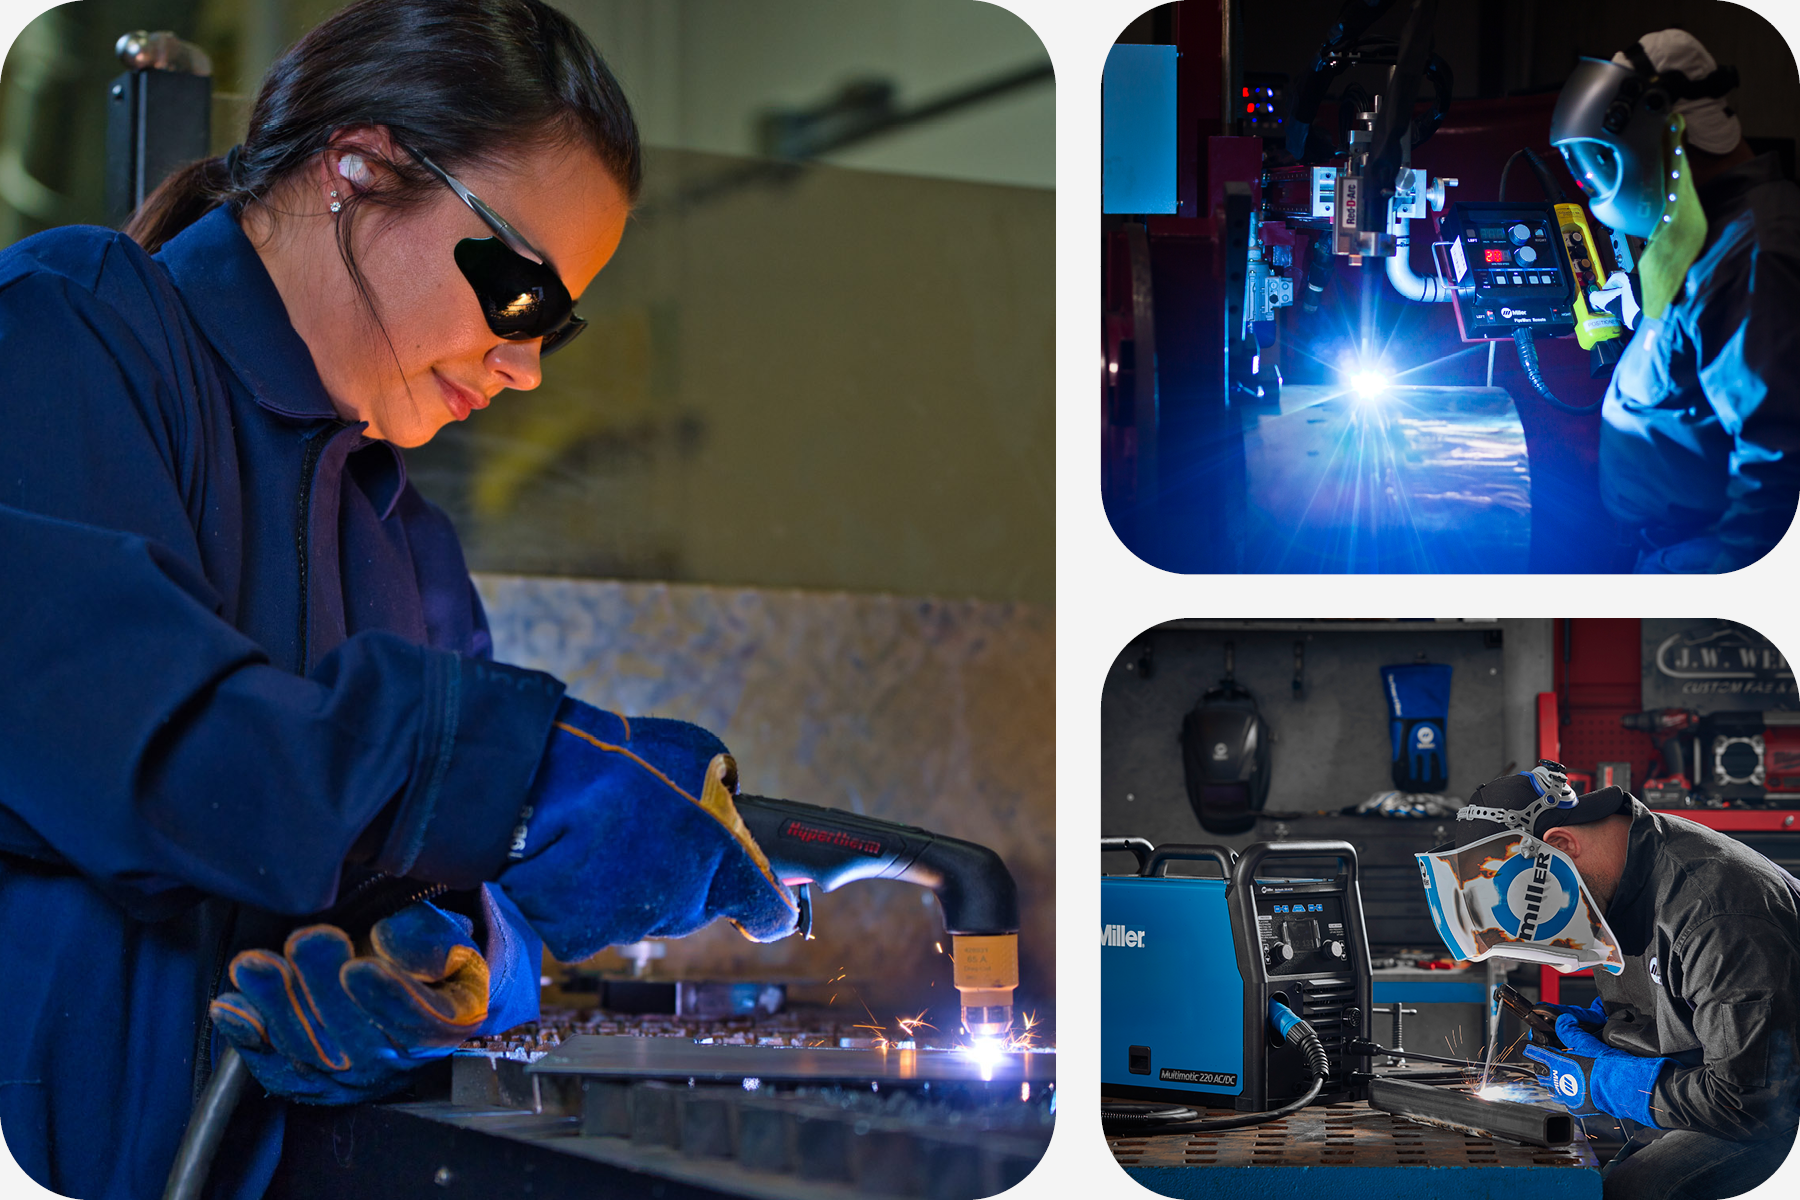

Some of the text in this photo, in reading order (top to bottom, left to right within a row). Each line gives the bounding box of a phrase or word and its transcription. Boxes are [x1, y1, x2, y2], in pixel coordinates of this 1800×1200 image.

[1346, 184, 1356, 225] Red-D-Arc
[1682, 681, 1741, 694] CUSTOM
[787, 821, 881, 854] Hypertherm
[1161, 1070, 1236, 1084] Multimatic 220 AC/DC
